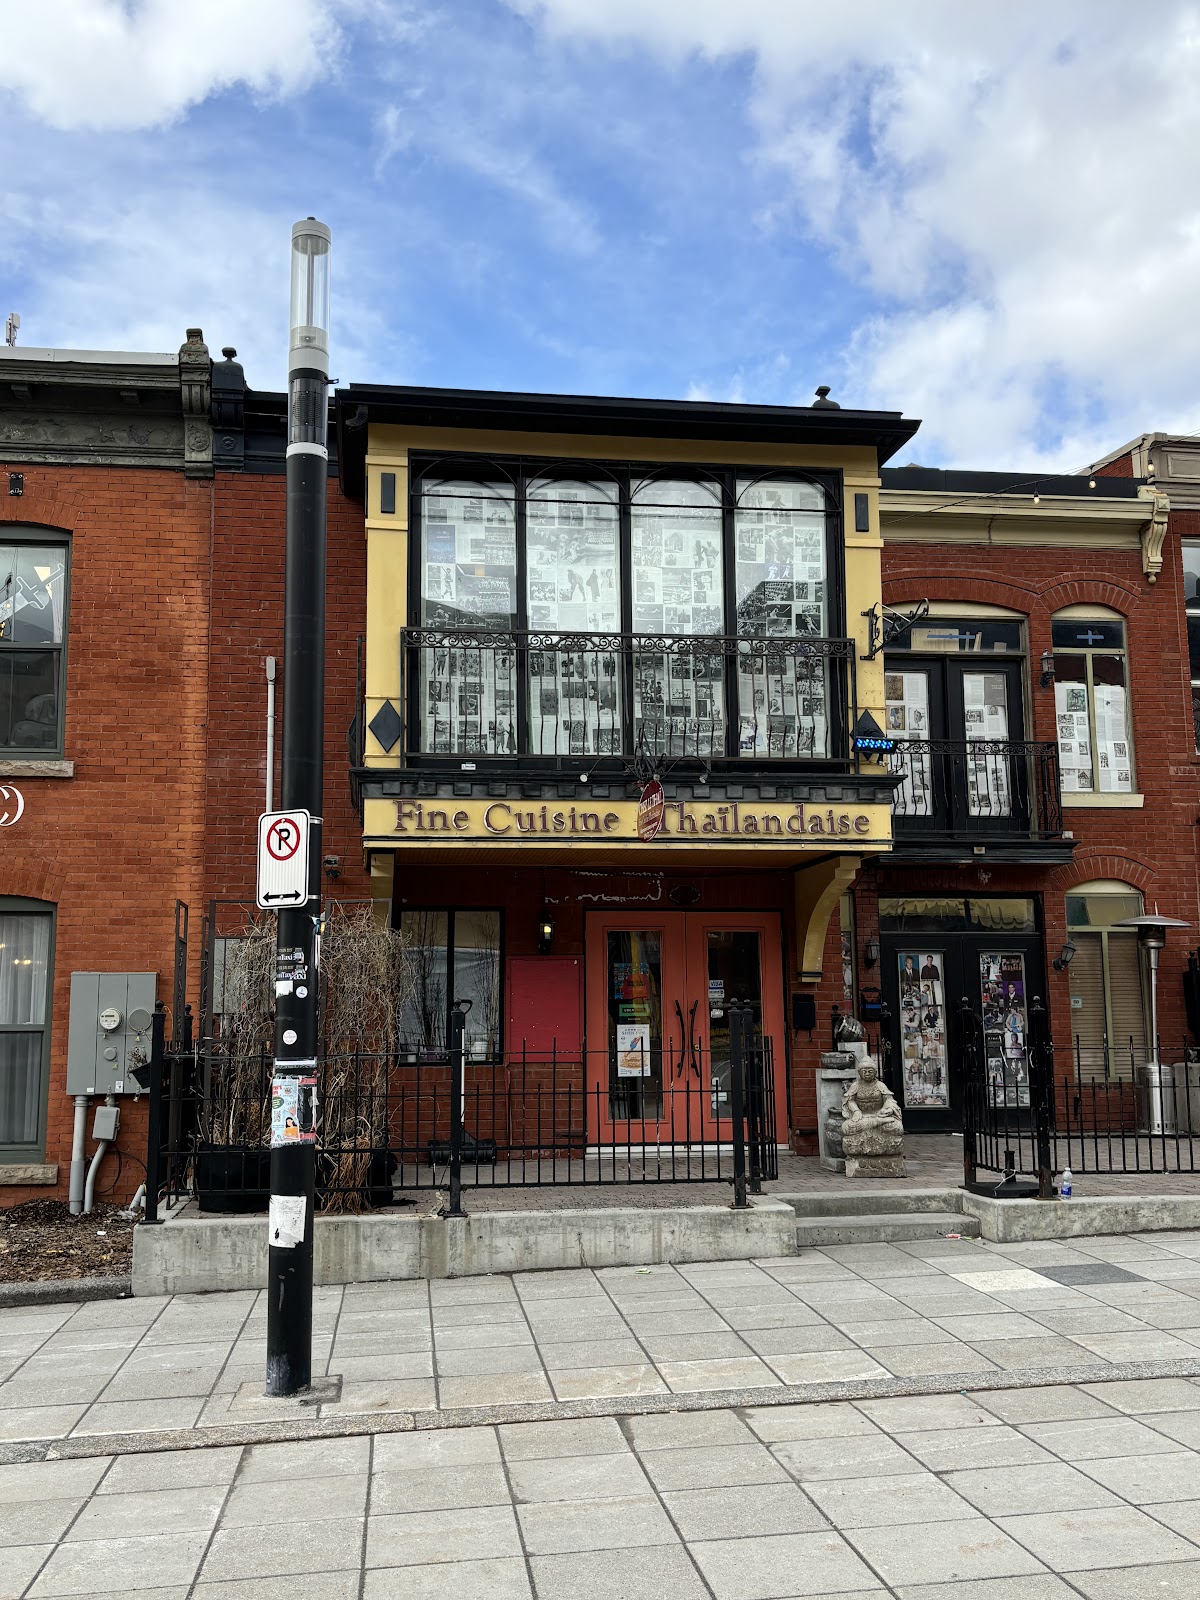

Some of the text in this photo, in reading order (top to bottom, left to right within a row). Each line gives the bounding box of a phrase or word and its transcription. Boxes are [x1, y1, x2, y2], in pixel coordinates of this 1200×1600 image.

[393, 800, 470, 831] Fine
[483, 802, 620, 834] Cuisine
[660, 801, 870, 834] Thaïlandaise
[278, 828, 291, 851] P
